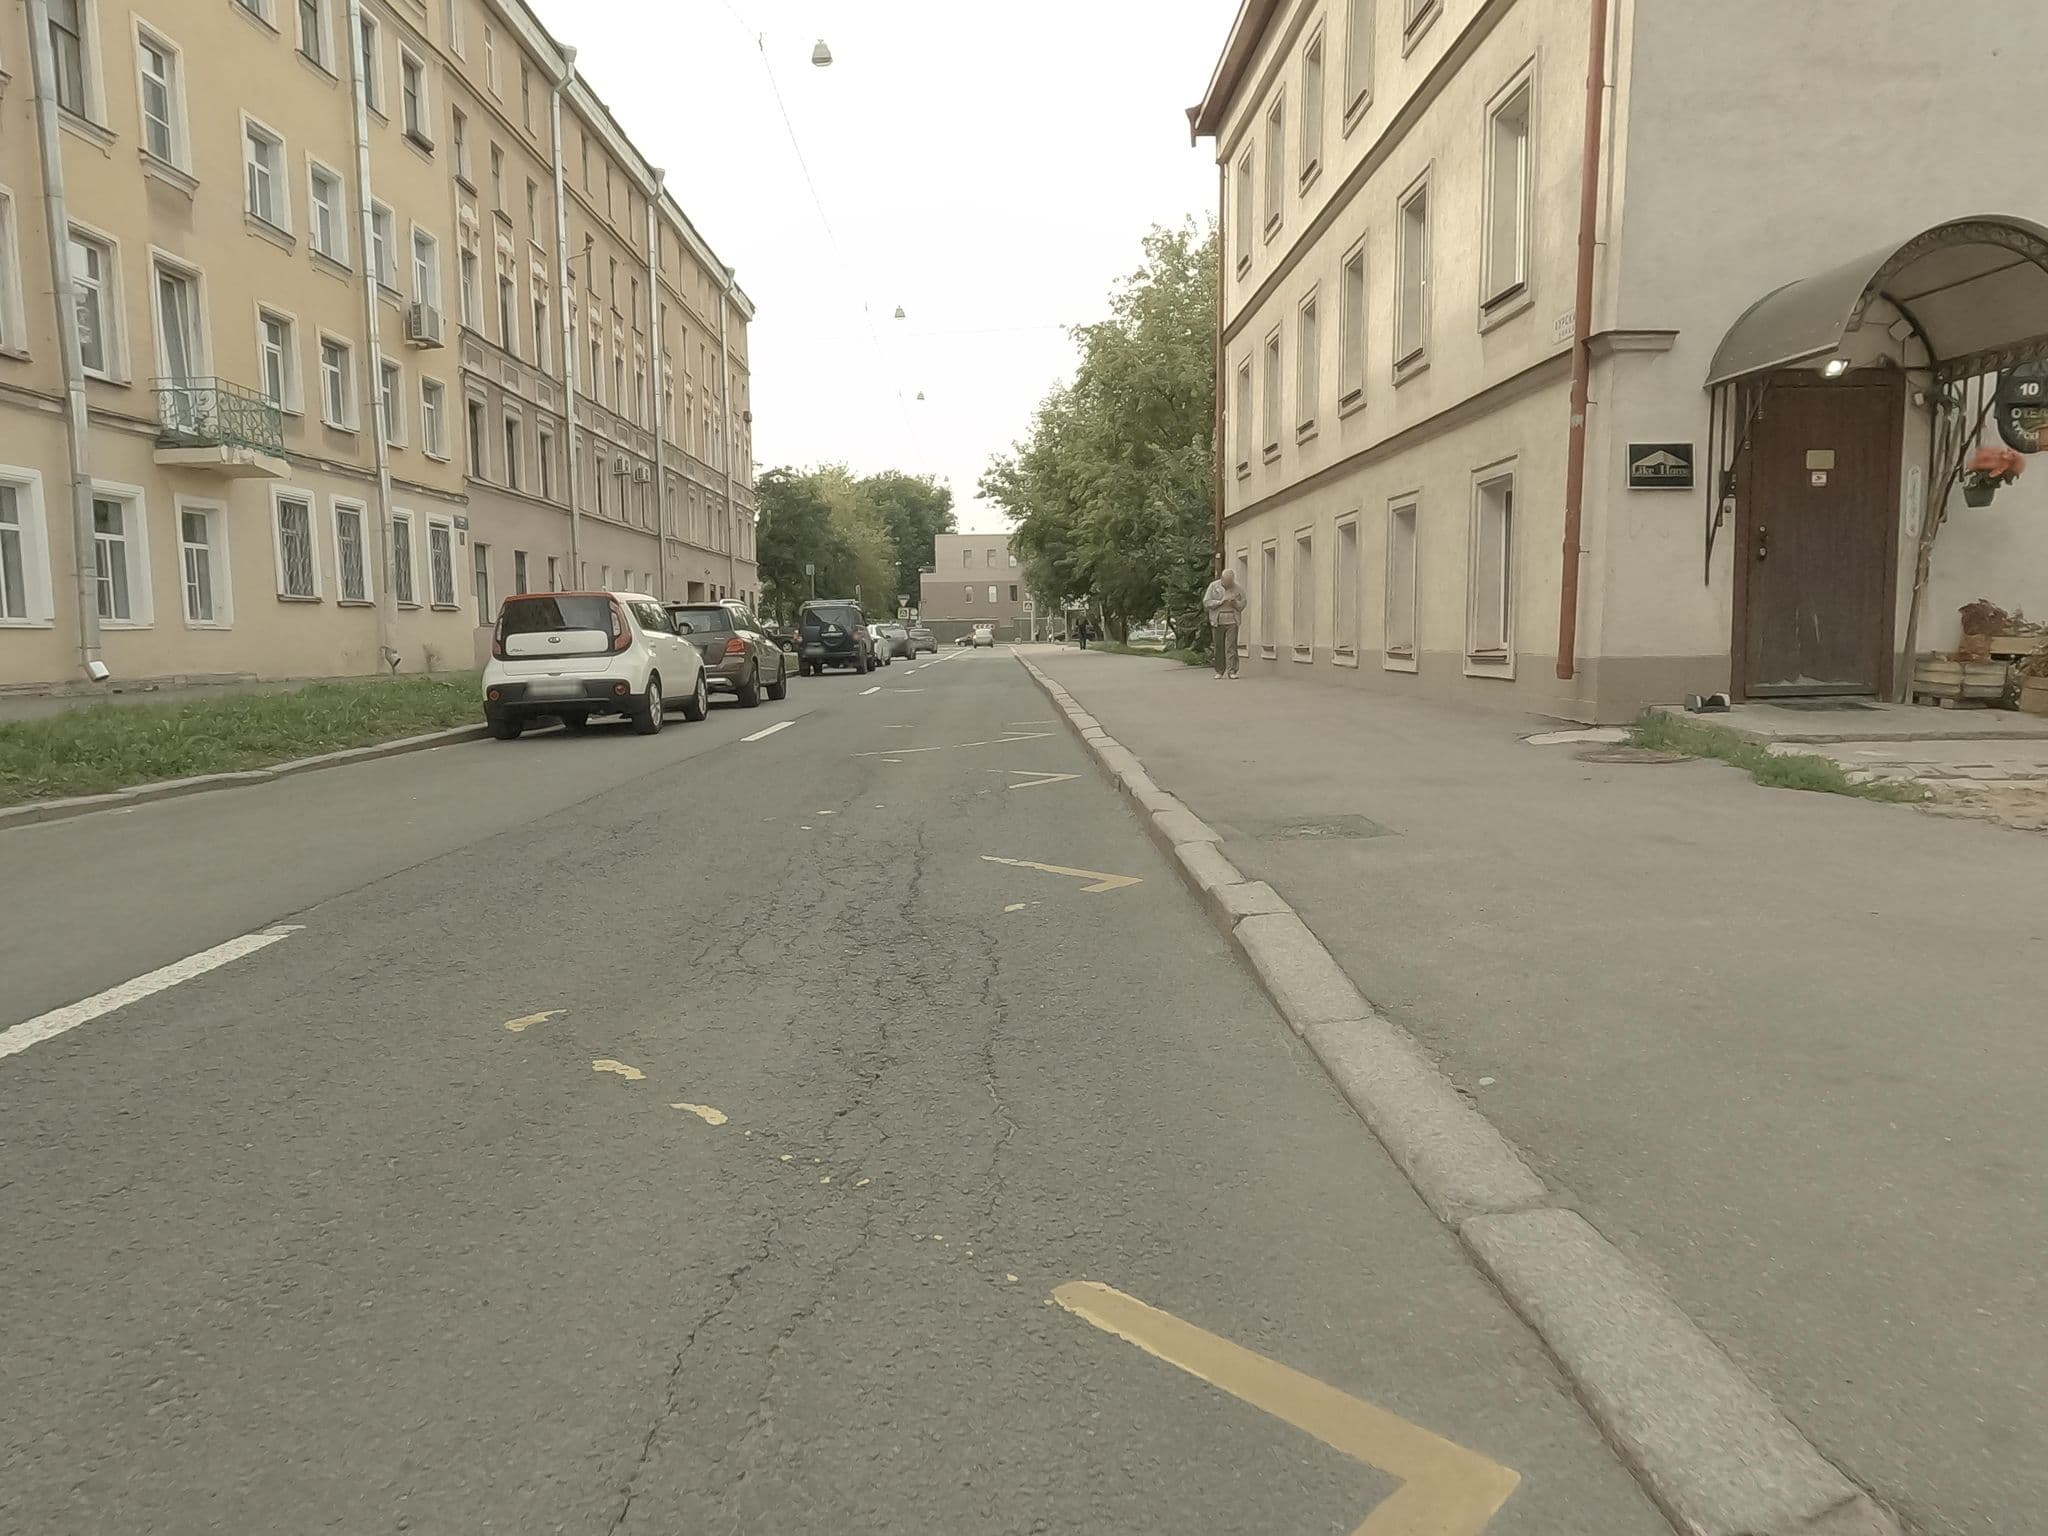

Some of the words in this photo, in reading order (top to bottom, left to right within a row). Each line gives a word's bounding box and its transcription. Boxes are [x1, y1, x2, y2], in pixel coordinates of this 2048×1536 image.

[2019, 382, 2040, 396] 10
[2010, 407, 2048, 419] ОТЕЛ
[1632, 464, 1655, 476] Like
